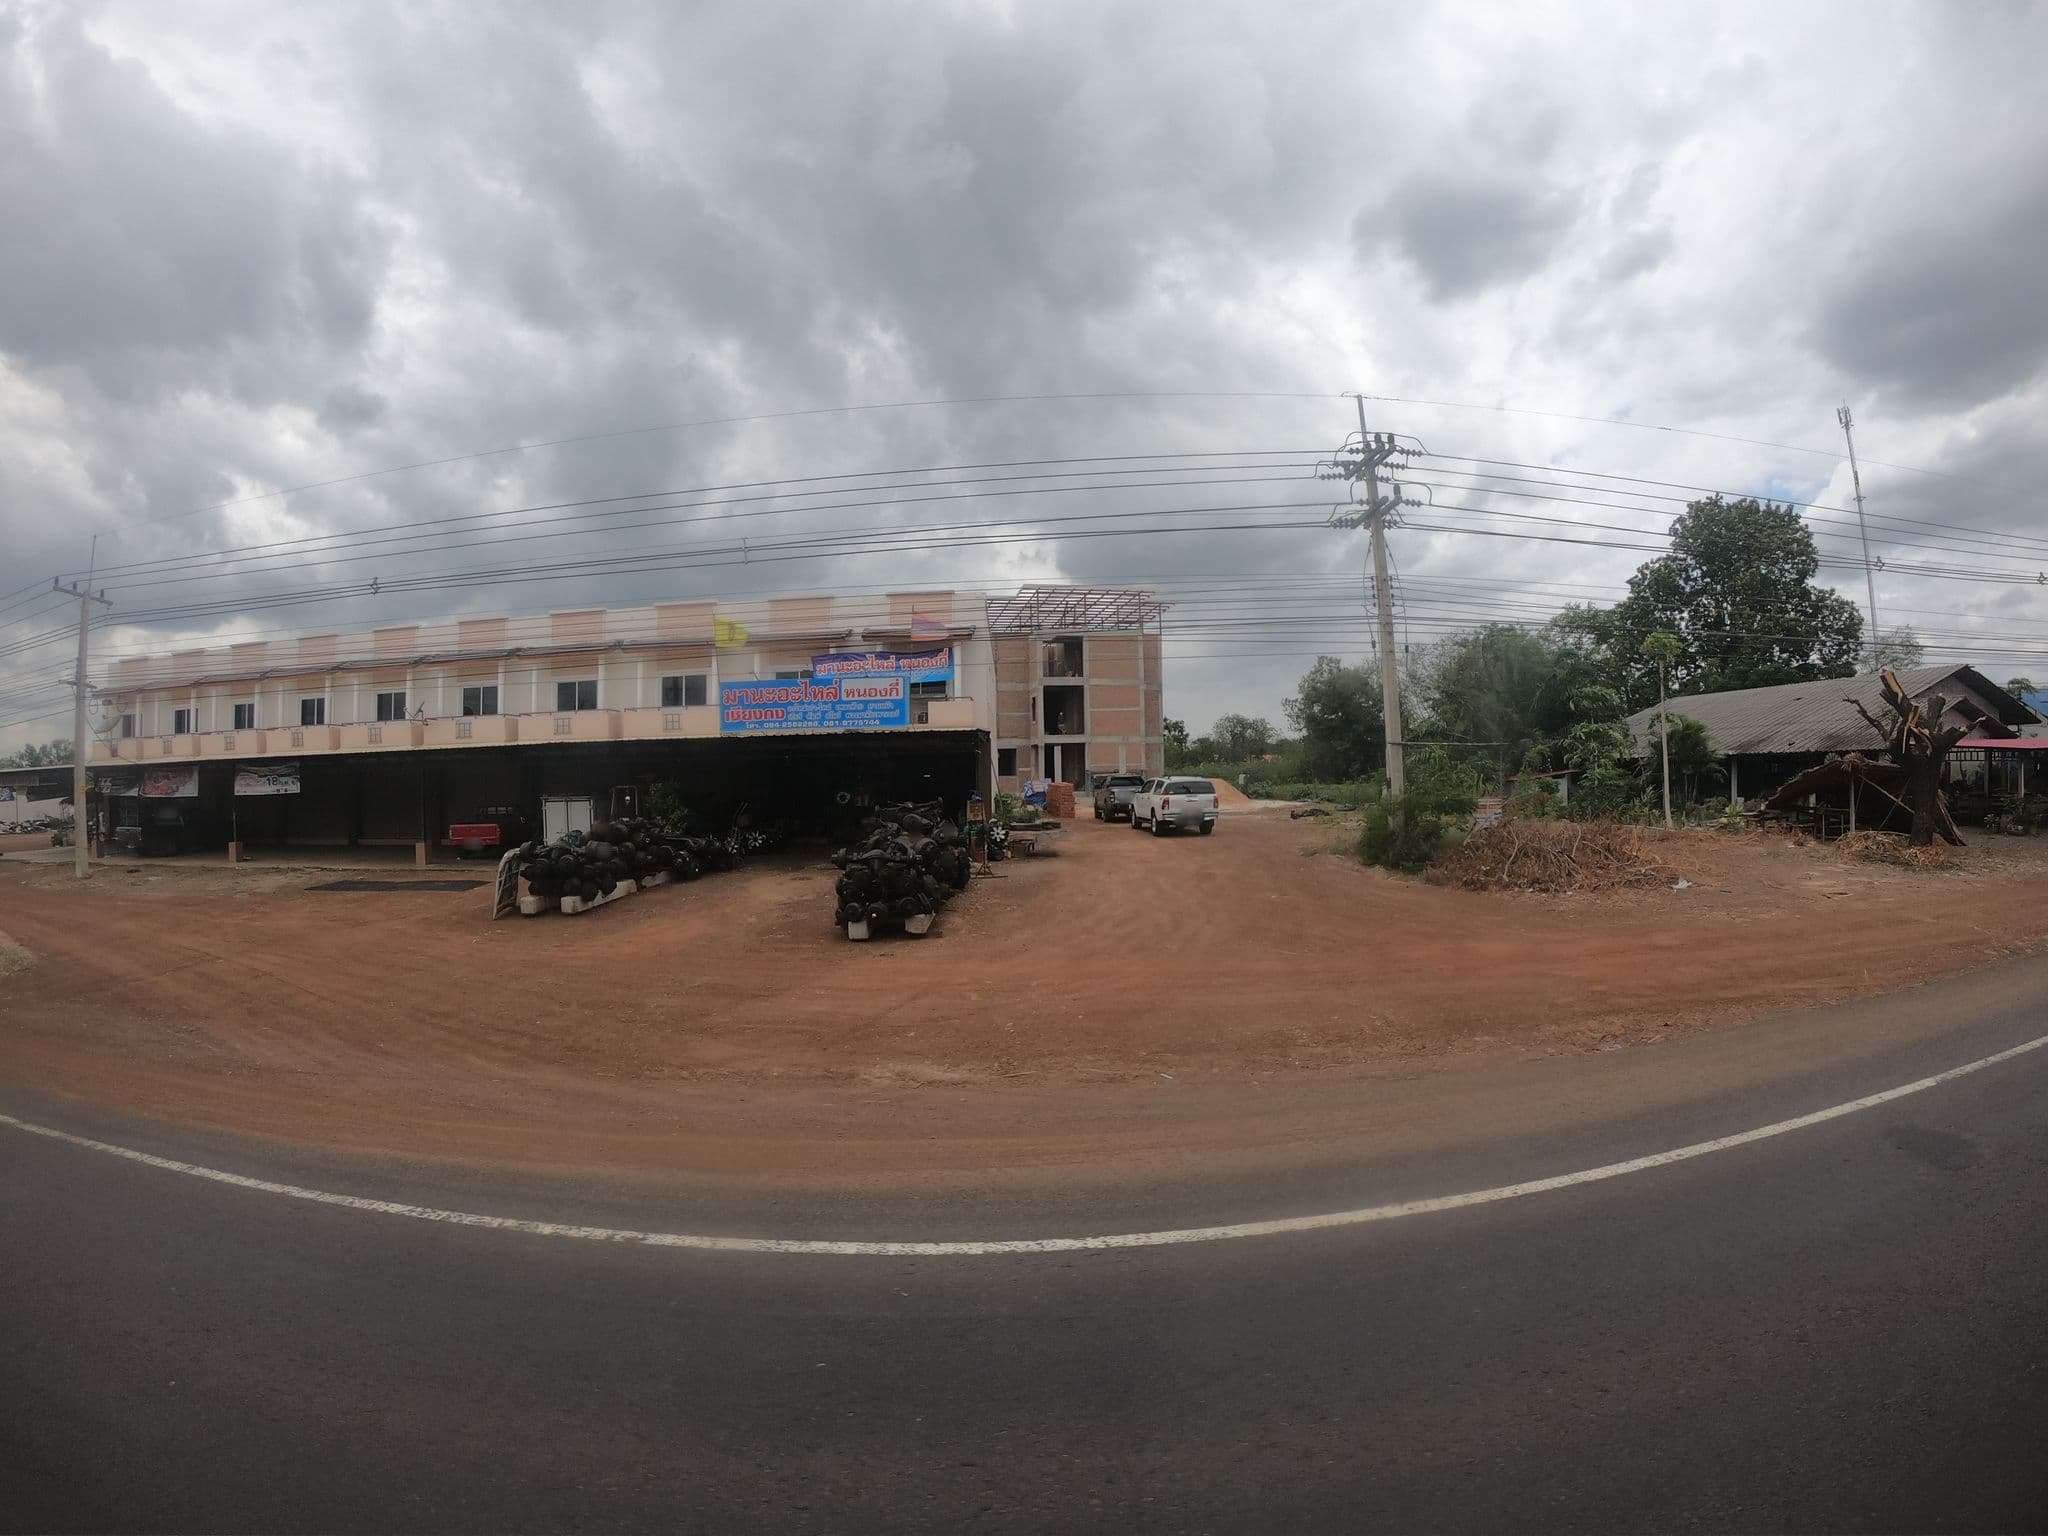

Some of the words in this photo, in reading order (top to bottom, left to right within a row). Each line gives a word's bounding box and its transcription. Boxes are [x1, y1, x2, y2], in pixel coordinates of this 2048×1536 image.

[722, 679, 840, 706] มานะอะไหล่
[843, 678, 900, 699] หนองกี่
